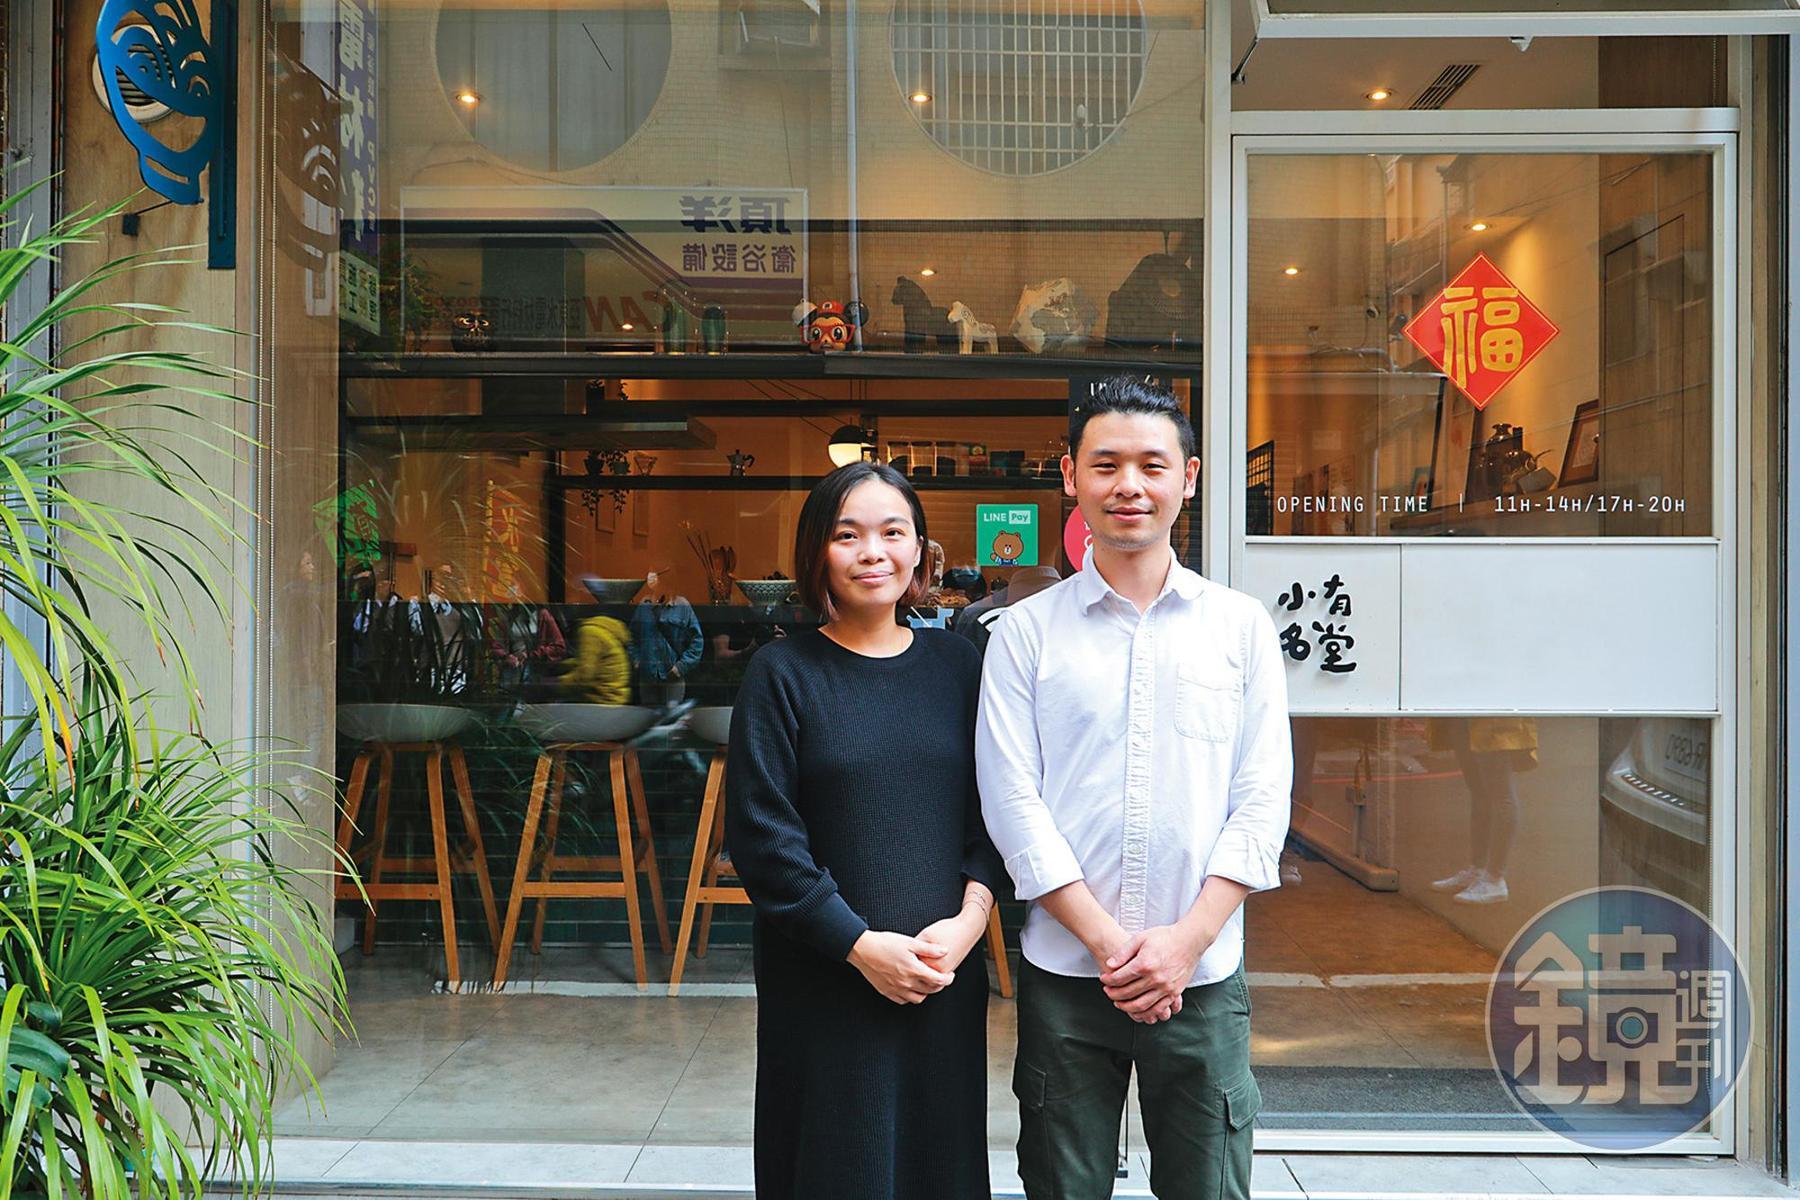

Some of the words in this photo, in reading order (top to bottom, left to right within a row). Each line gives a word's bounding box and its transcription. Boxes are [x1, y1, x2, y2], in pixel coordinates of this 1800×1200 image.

[1440, 286, 1524, 389] 福
[983, 512, 1007, 522] LINE
[1010, 511, 1030, 523] Pay
[1277, 496, 1364, 513] OPENING
[1380, 496, 1428, 513] TIME
[1278, 574, 1352, 617] 小有
[1279, 621, 1357, 674] 名堂
